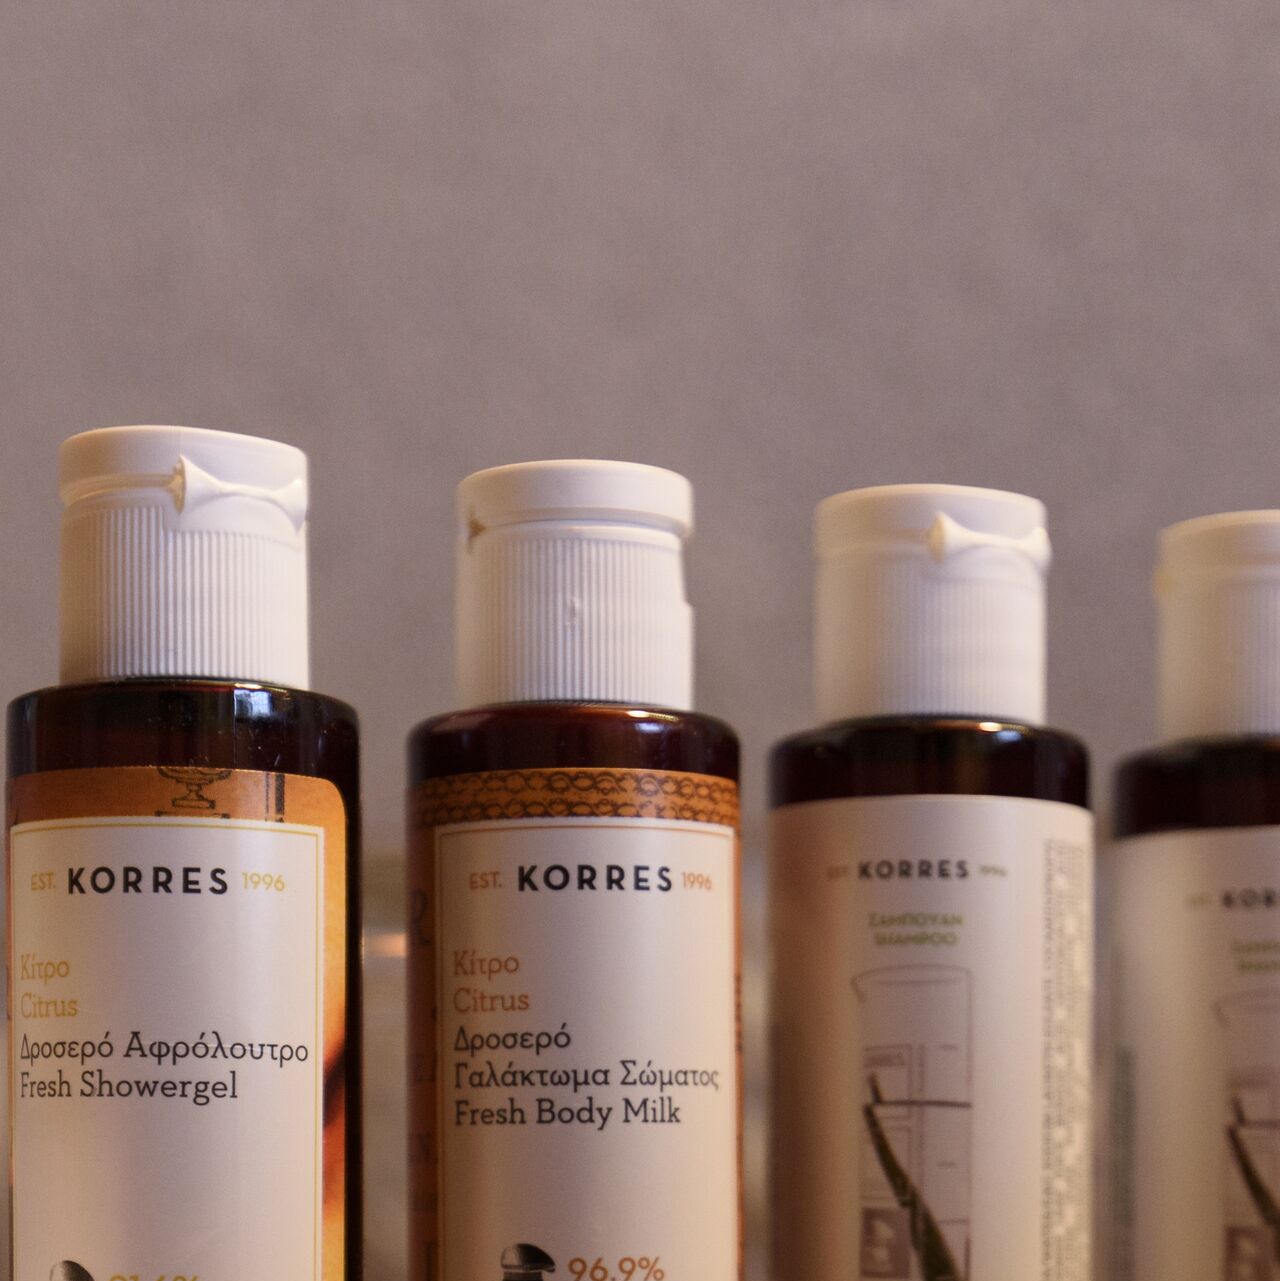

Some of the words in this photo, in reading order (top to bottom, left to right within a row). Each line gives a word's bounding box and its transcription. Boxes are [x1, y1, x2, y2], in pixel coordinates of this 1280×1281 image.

[31, 872, 56, 891] EST.
[67, 866, 229, 895] KORRES
[242, 872, 286, 892] 1996
[470, 871, 503, 890] EST.
[517, 864, 673, 892] KORRES
[681, 871, 713, 891] 1996
[857, 860, 970, 880] KORRES
[20, 954, 70, 984] Κίτρο
[453, 951, 520, 981] Κίτρο
[20, 992, 79, 1018] Citrus
[453, 986, 530, 1013] Citrus
[20, 1031, 114, 1066] Δροσερό
[123, 1031, 309, 1068] Αφρόλουτρο
[454, 1022, 572, 1056] Δροσερό
[20, 1070, 72, 1099] Fresh
[80, 1069, 238, 1106] Showergel
[454, 1060, 610, 1093] Γαλάκτωμα
[619, 1059, 720, 1091] Σώματος
[455, 1097, 527, 1126] Fresh
[536, 1097, 613, 1131] Body
[621, 1096, 681, 1124] Milk
